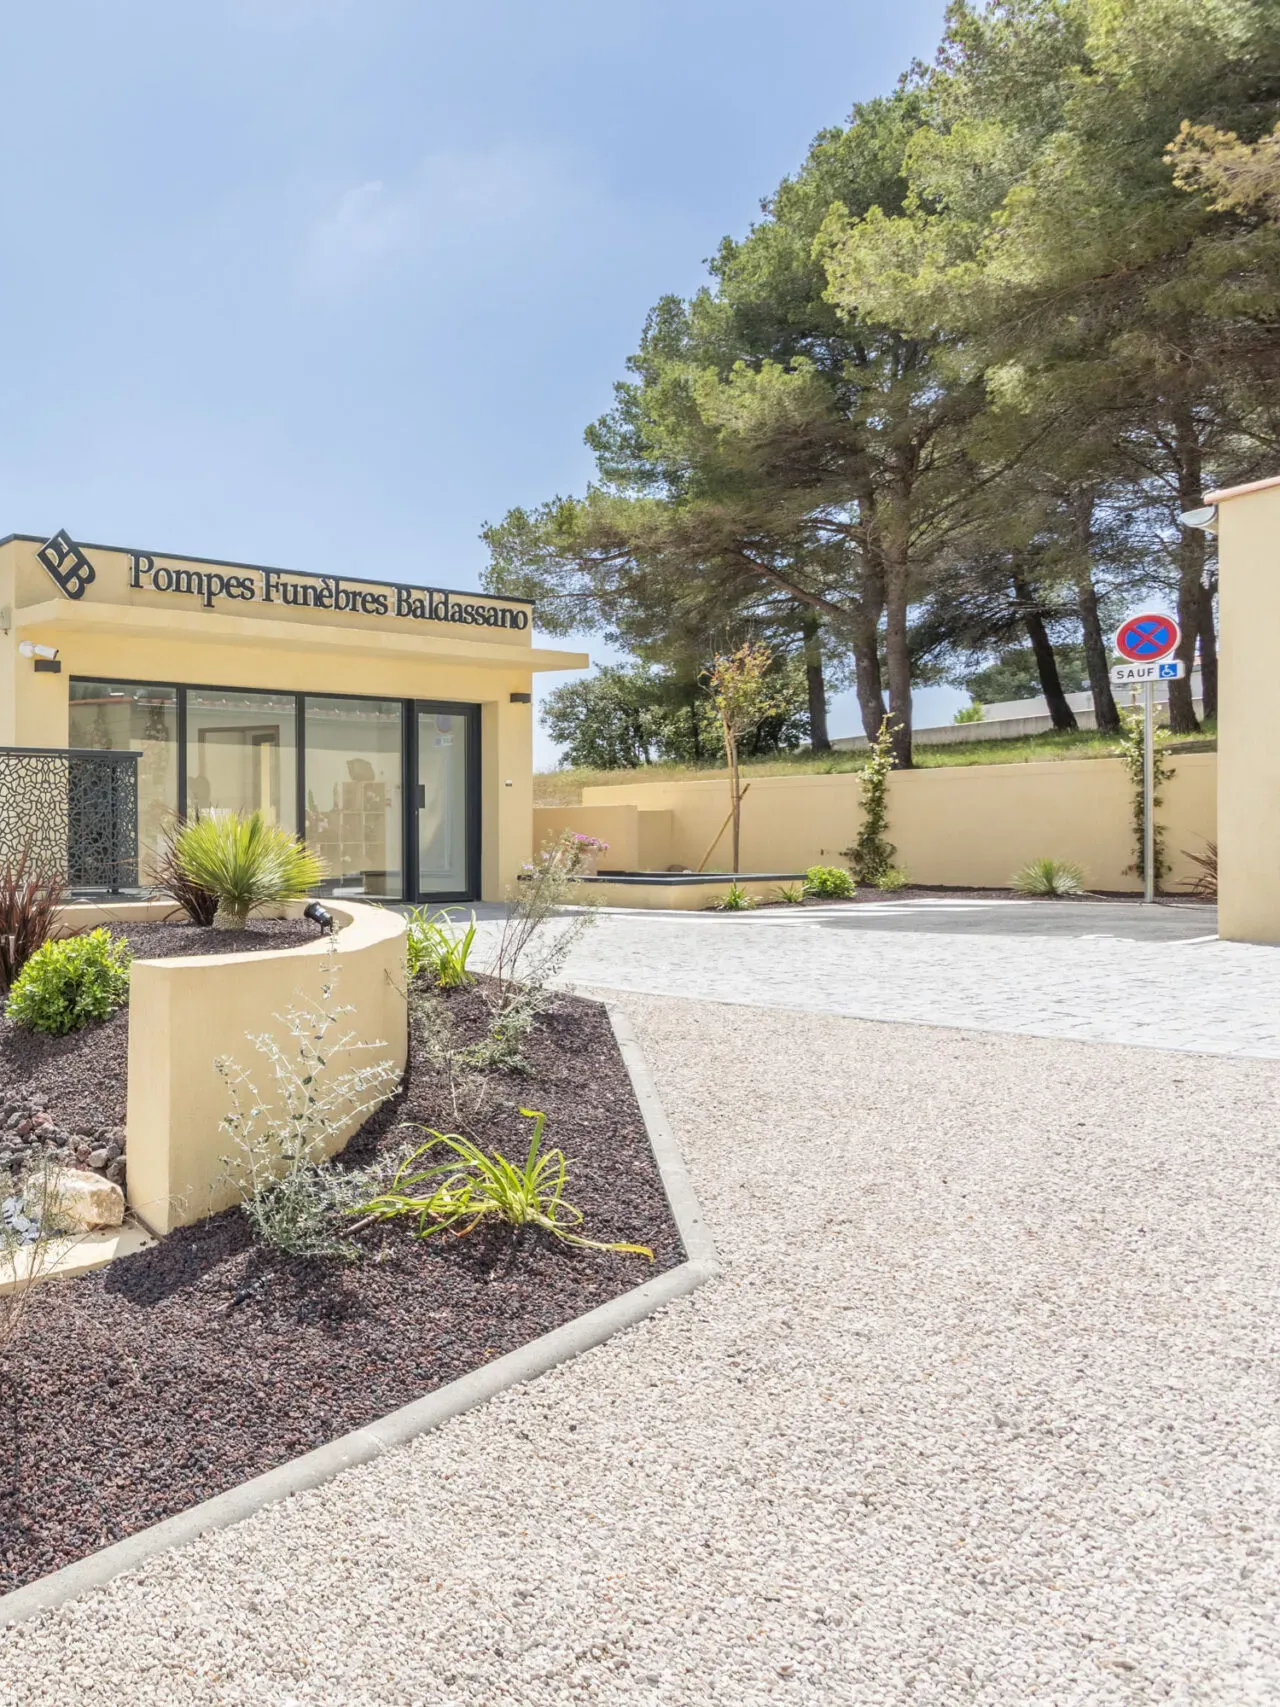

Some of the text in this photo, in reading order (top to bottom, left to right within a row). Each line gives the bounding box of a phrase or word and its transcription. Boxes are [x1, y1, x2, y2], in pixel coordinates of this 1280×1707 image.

[129, 553, 528, 631] Pompes Funèbres Baldassano
[1116, 667, 1155, 680] SAUF
